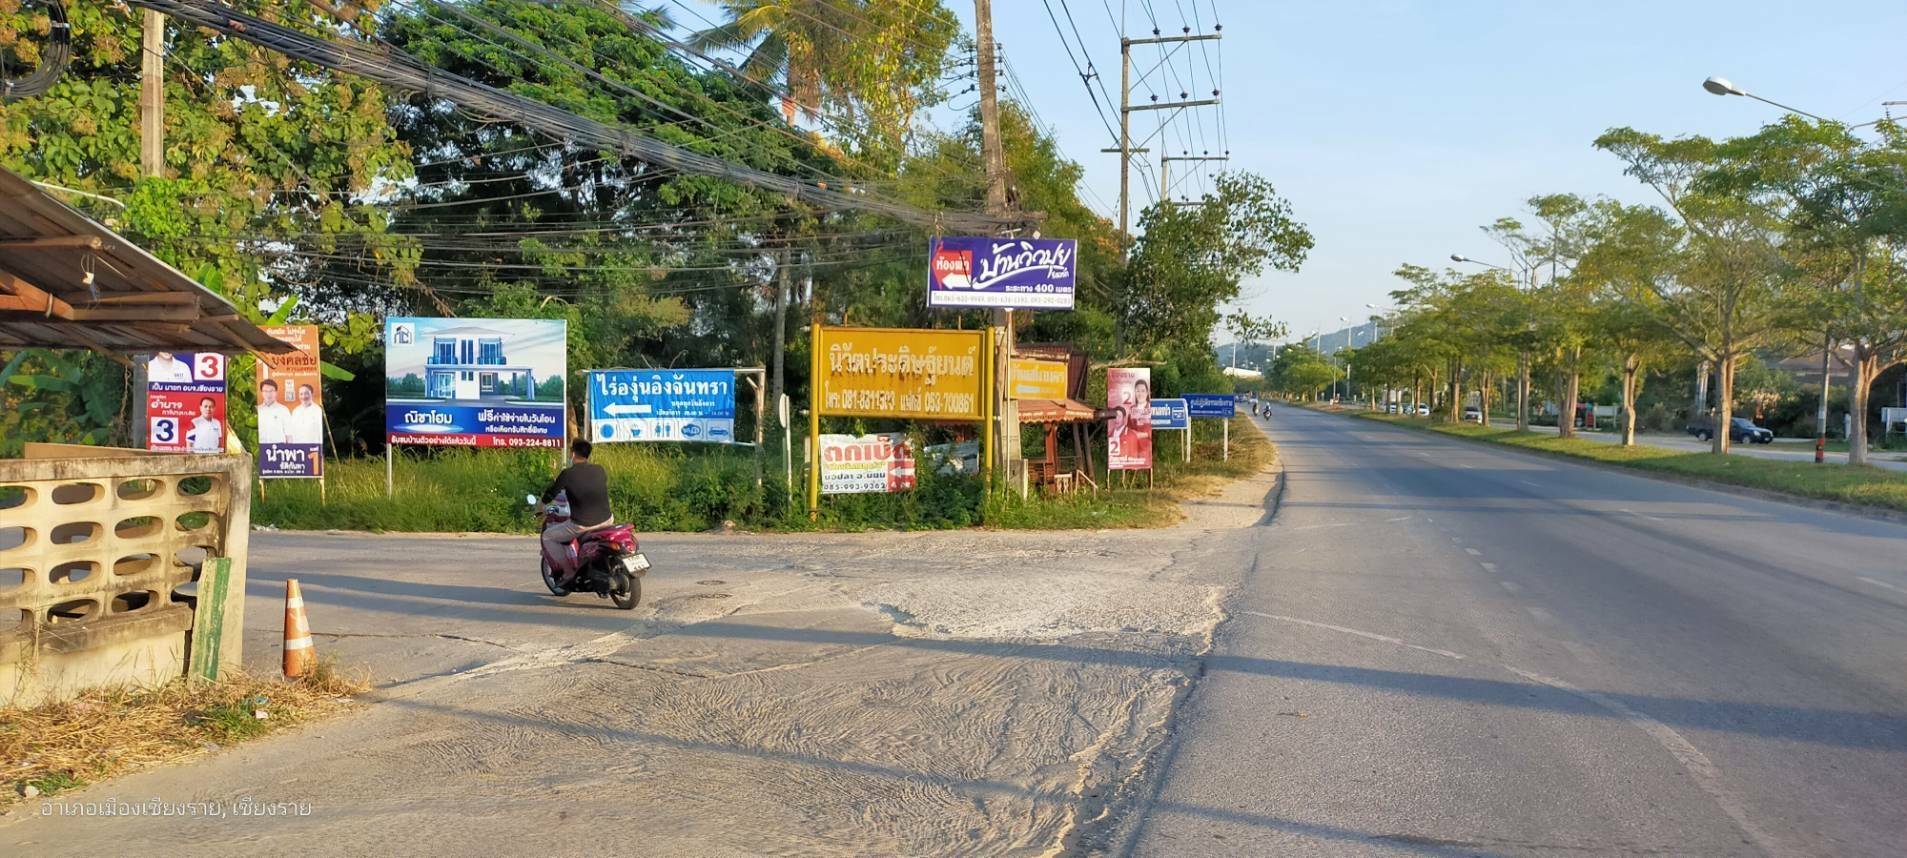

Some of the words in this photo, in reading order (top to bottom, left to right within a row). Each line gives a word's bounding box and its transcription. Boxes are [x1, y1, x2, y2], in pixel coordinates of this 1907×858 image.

[1034, 284, 1054, 292] 400
[200, 355, 218, 378] 3
[151, 382, 163, 392] เป็น
[165, 384, 182, 392] นายก
[596, 373, 728, 402] ไร่องุ่นอิงจันทรา
[1123, 391, 1132, 405] 2
[404, 410, 452, 424] ณิชาโฮม
[478, 409, 556, 424] ฟรีค่าใช้จ่ายในวันโอน
[155, 419, 174, 442] 3
[493, 436, 507, 446] โทร.
[1110, 441, 1119, 454] 2
[308, 452, 319, 475] 1
